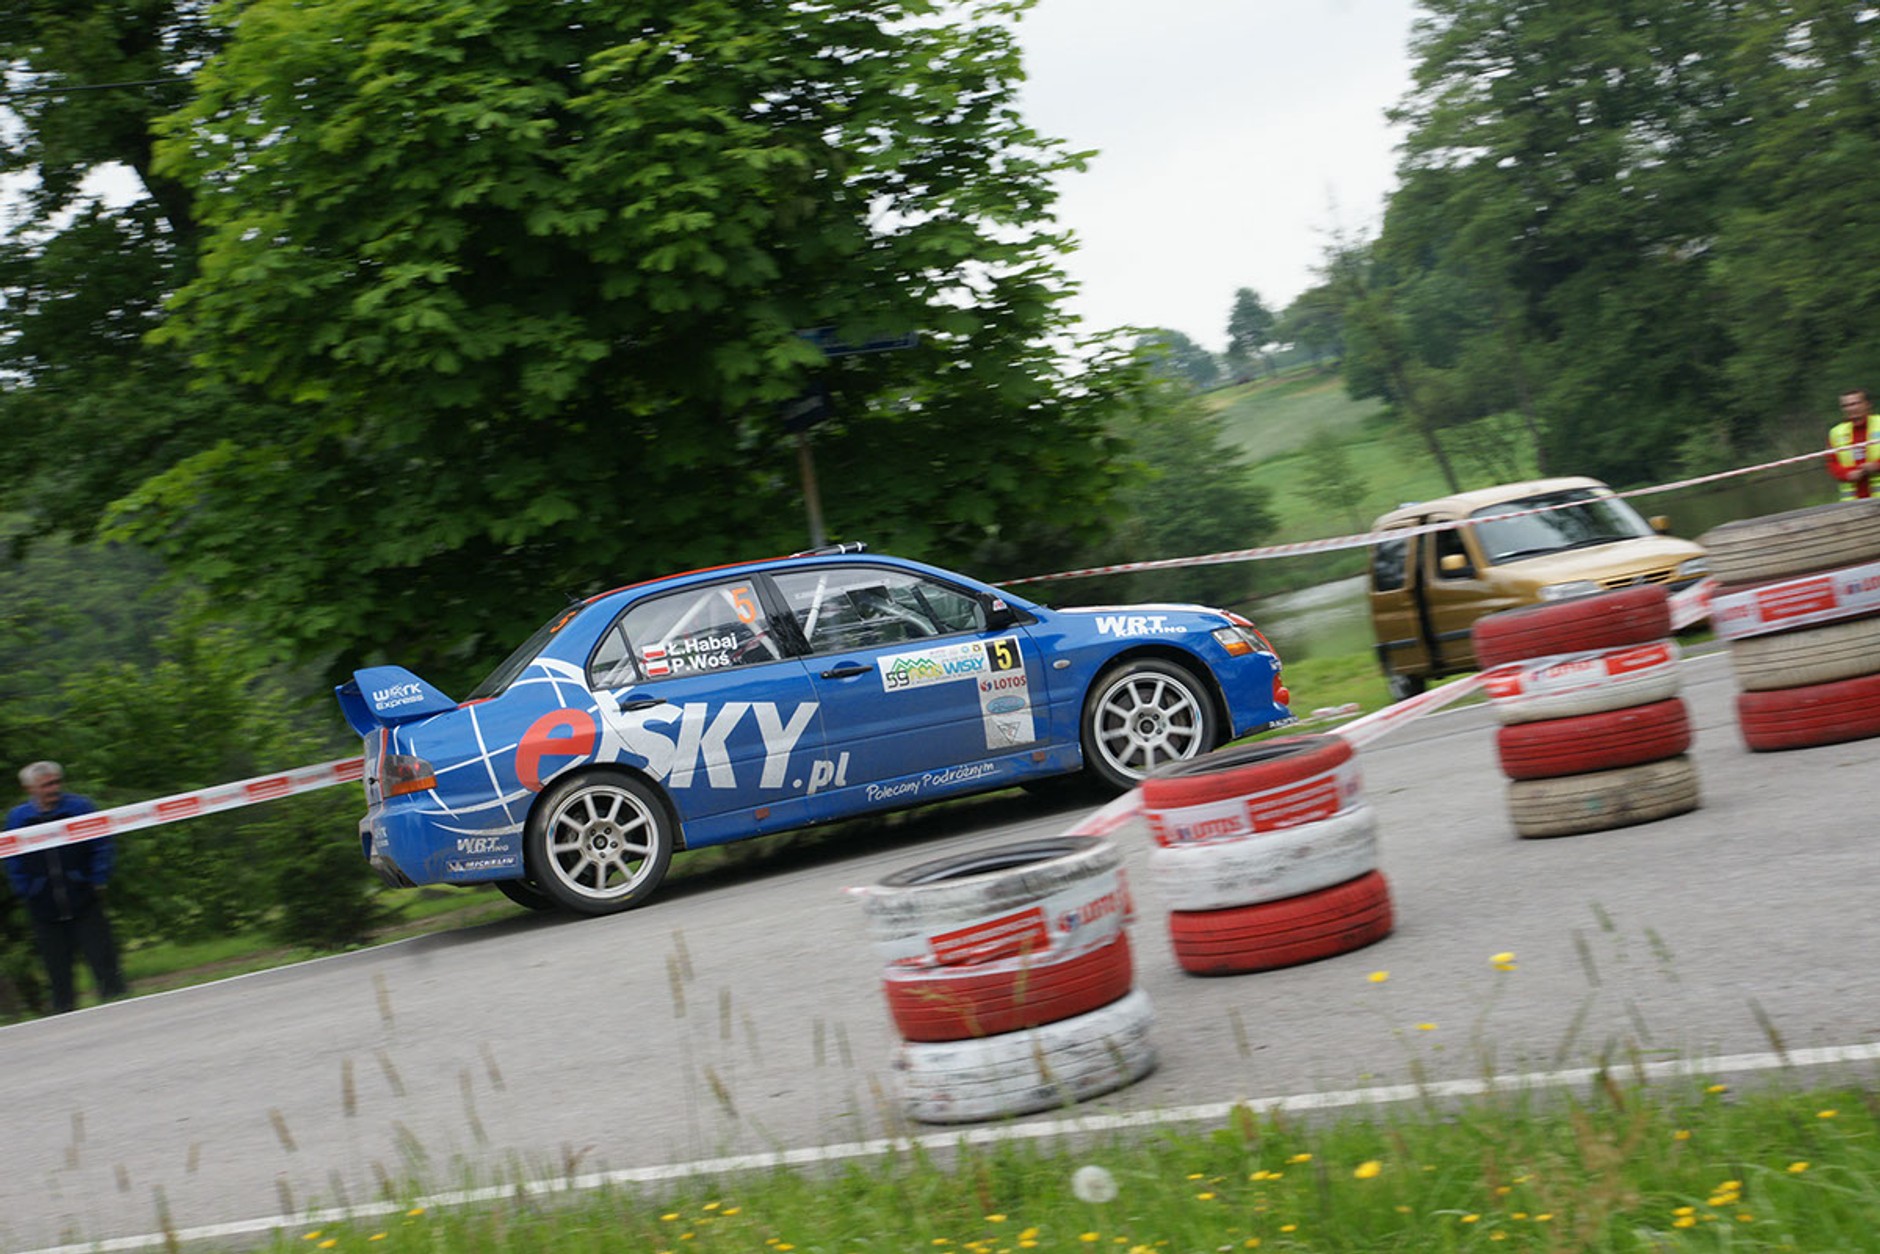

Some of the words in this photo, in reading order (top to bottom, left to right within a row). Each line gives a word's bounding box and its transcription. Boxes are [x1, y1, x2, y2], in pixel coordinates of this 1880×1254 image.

[731, 587, 757, 624] 5
[1095, 616, 1167, 635] WRT
[1115, 626, 1187, 637] KARTING
[994, 640, 1012, 670] 5
[886, 669, 910, 689] 59
[995, 675, 1026, 691] LOTOS
[866, 781, 920, 802] Polecany
[457, 837, 499, 852] WRT
